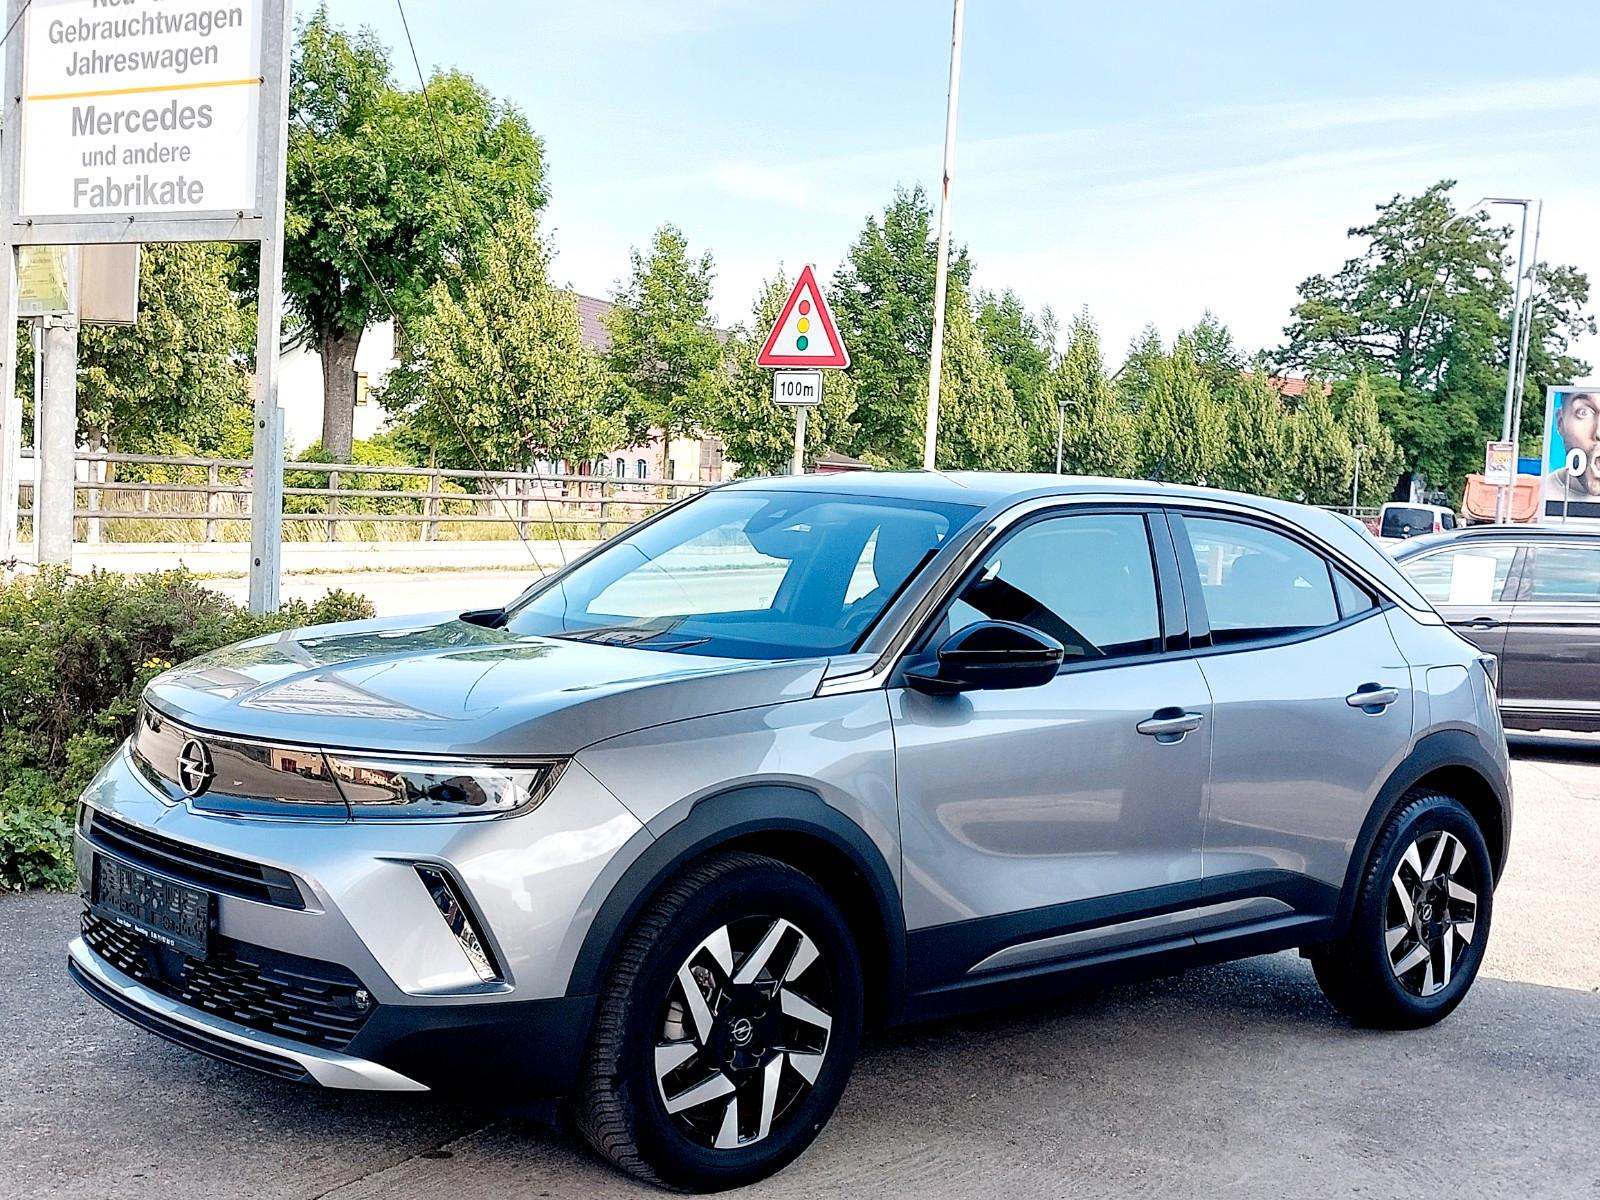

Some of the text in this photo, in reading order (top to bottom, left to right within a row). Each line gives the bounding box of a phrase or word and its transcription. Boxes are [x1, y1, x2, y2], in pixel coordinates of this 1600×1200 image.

[49, 7, 243, 44] Gebrauchtwagen
[66, 44, 219, 77] Jahreswagen
[71, 100, 213, 137] Mercedes
[82, 143, 191, 167] und andere
[73, 175, 204, 208] Fabrikate
[780, 381, 814, 397] 100m
